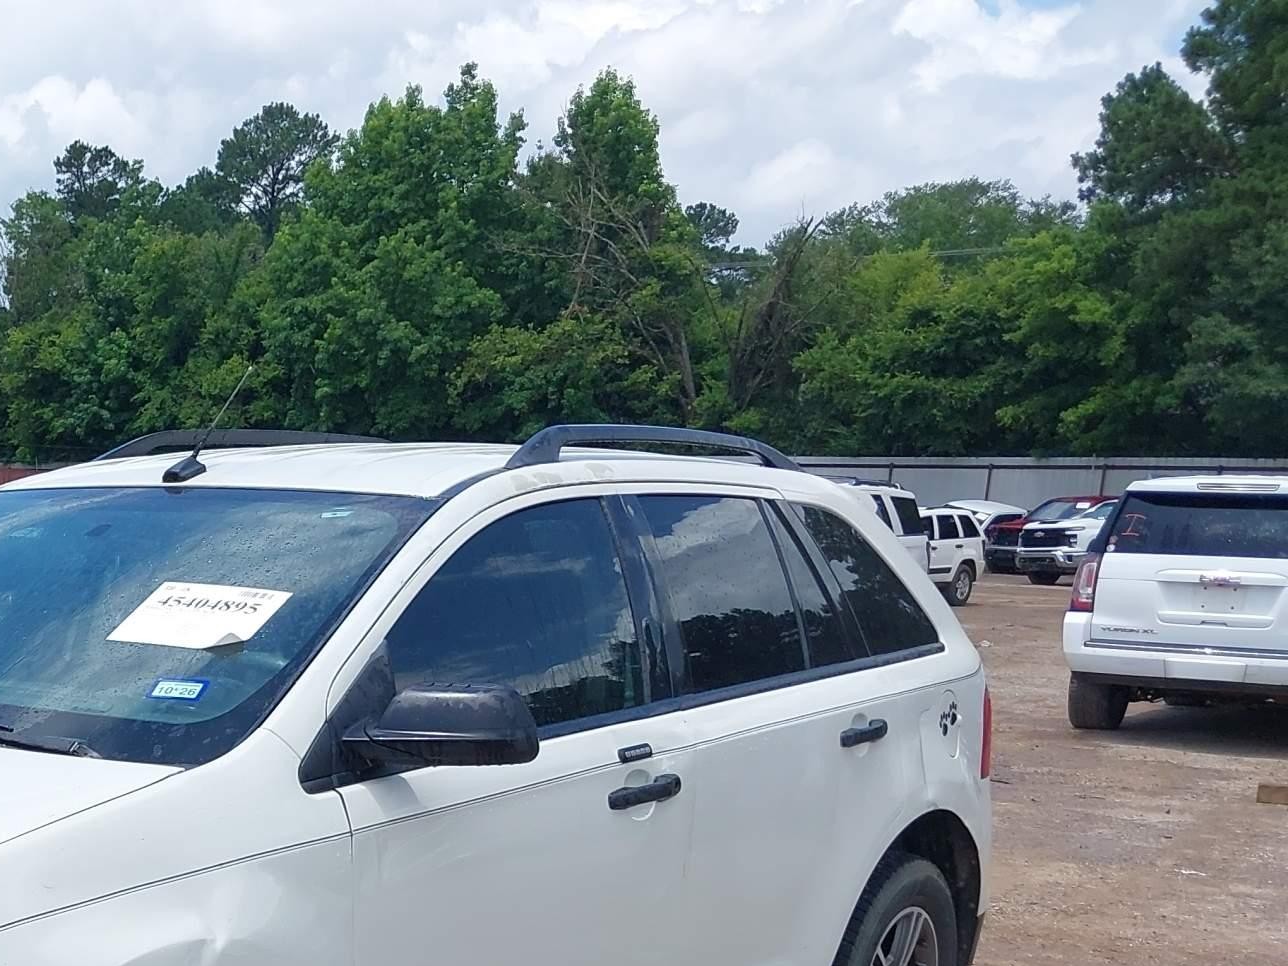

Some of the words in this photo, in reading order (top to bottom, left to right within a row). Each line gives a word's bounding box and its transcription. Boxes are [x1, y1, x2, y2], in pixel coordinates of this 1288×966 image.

[158, 595, 263, 615] 45404895
[158, 685, 173, 695] 10
[178, 686, 198, 696] 26
